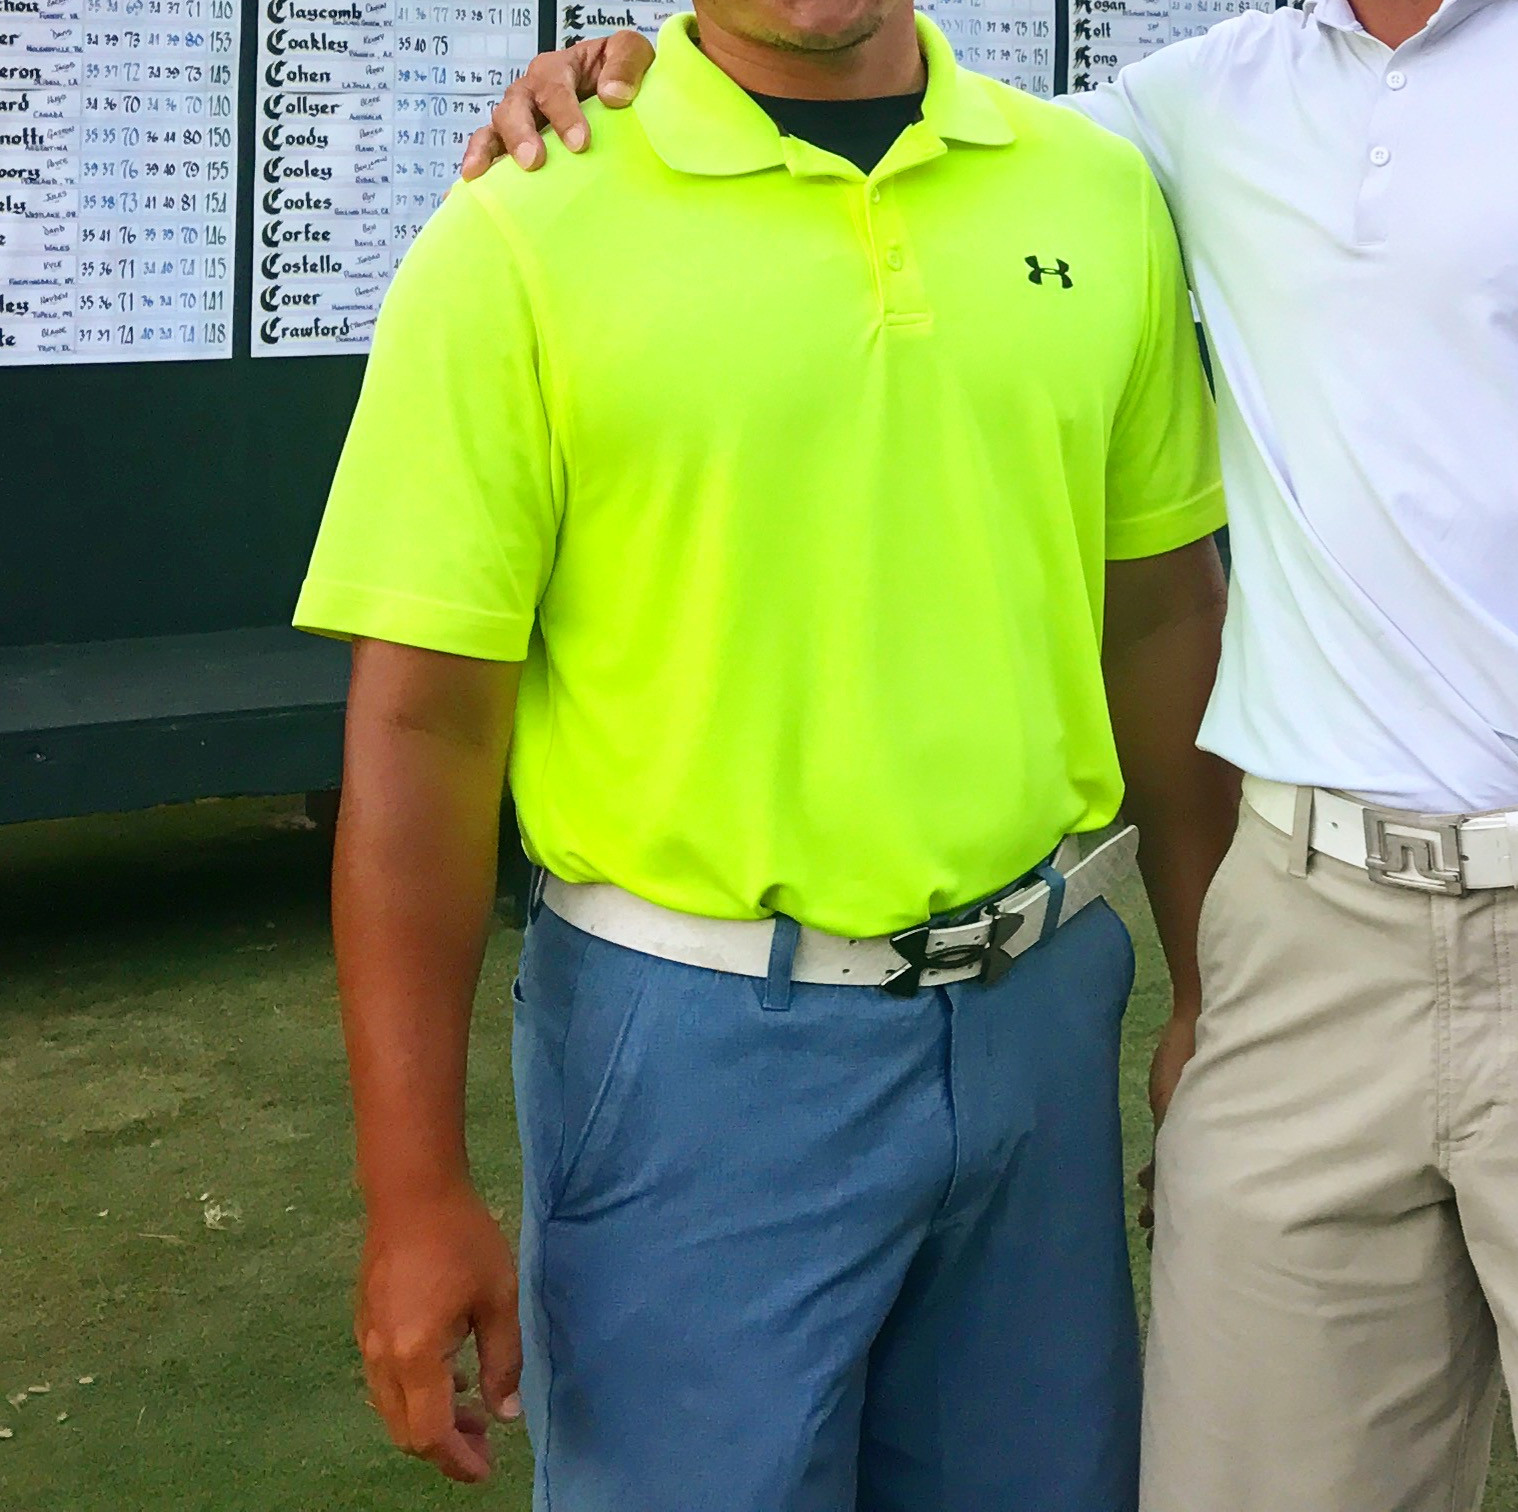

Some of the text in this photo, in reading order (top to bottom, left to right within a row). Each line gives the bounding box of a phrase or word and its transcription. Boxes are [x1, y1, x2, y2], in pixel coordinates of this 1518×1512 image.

[563, 4, 636, 29] Eubank
[266, 29, 348, 55] Coakley
[265, 61, 330, 87] Cohen
[263, 94, 342, 120] Collyer
[263, 124, 328, 151] Coody
[263, 157, 332, 183] Cooley
[263, 188, 331, 215] Cootes
[261, 252, 342, 279] Costello
[260, 285, 321, 312] Cover
[260, 316, 350, 344] Crawford
